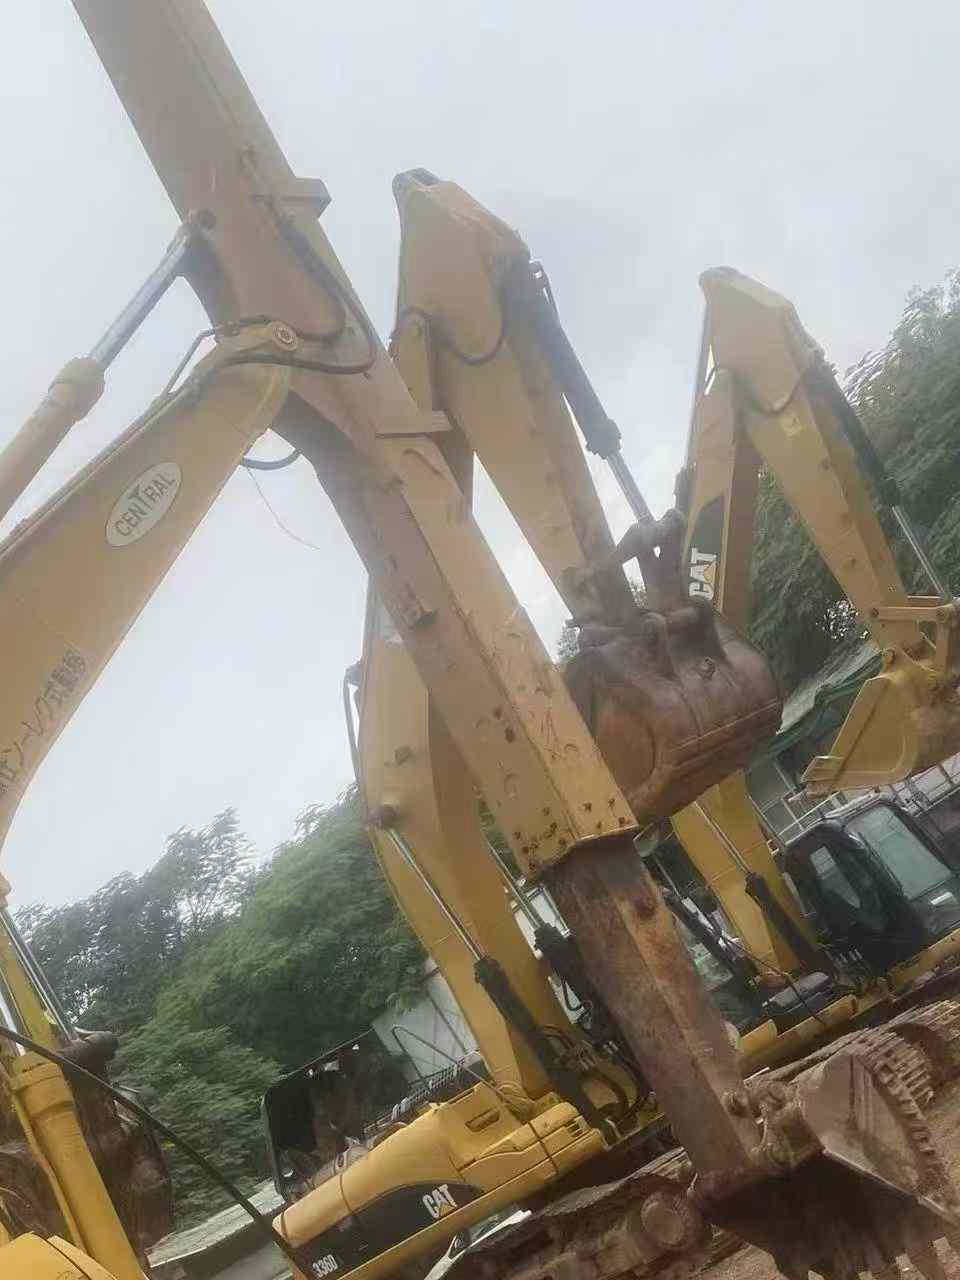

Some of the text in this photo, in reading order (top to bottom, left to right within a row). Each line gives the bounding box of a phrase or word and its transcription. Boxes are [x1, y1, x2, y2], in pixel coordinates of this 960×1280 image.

[114, 473, 176, 537] CENTRAL
[689, 547, 717, 600] CAT
[422, 1184, 458, 1219] CAT
